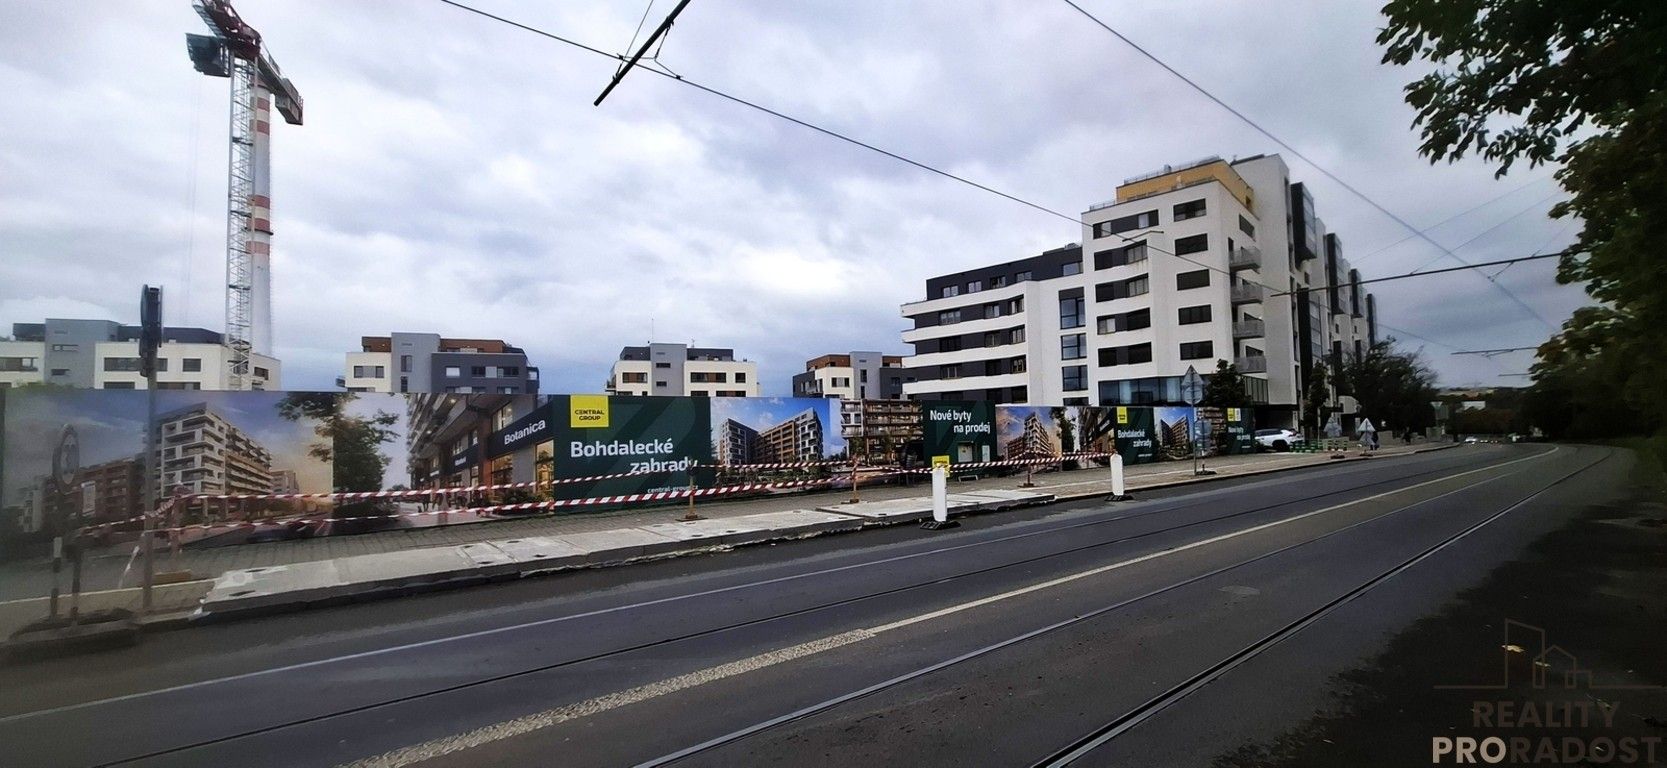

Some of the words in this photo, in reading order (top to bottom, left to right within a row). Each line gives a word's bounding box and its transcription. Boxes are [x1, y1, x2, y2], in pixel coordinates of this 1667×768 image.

[929, 409, 952, 421] Nové
[952, 409, 972, 423] byty
[504, 419, 546, 445] Botanica
[953, 424, 964, 433] na
[965, 421, 991, 435] prodej
[570, 437, 674, 458] Bohdalecké
